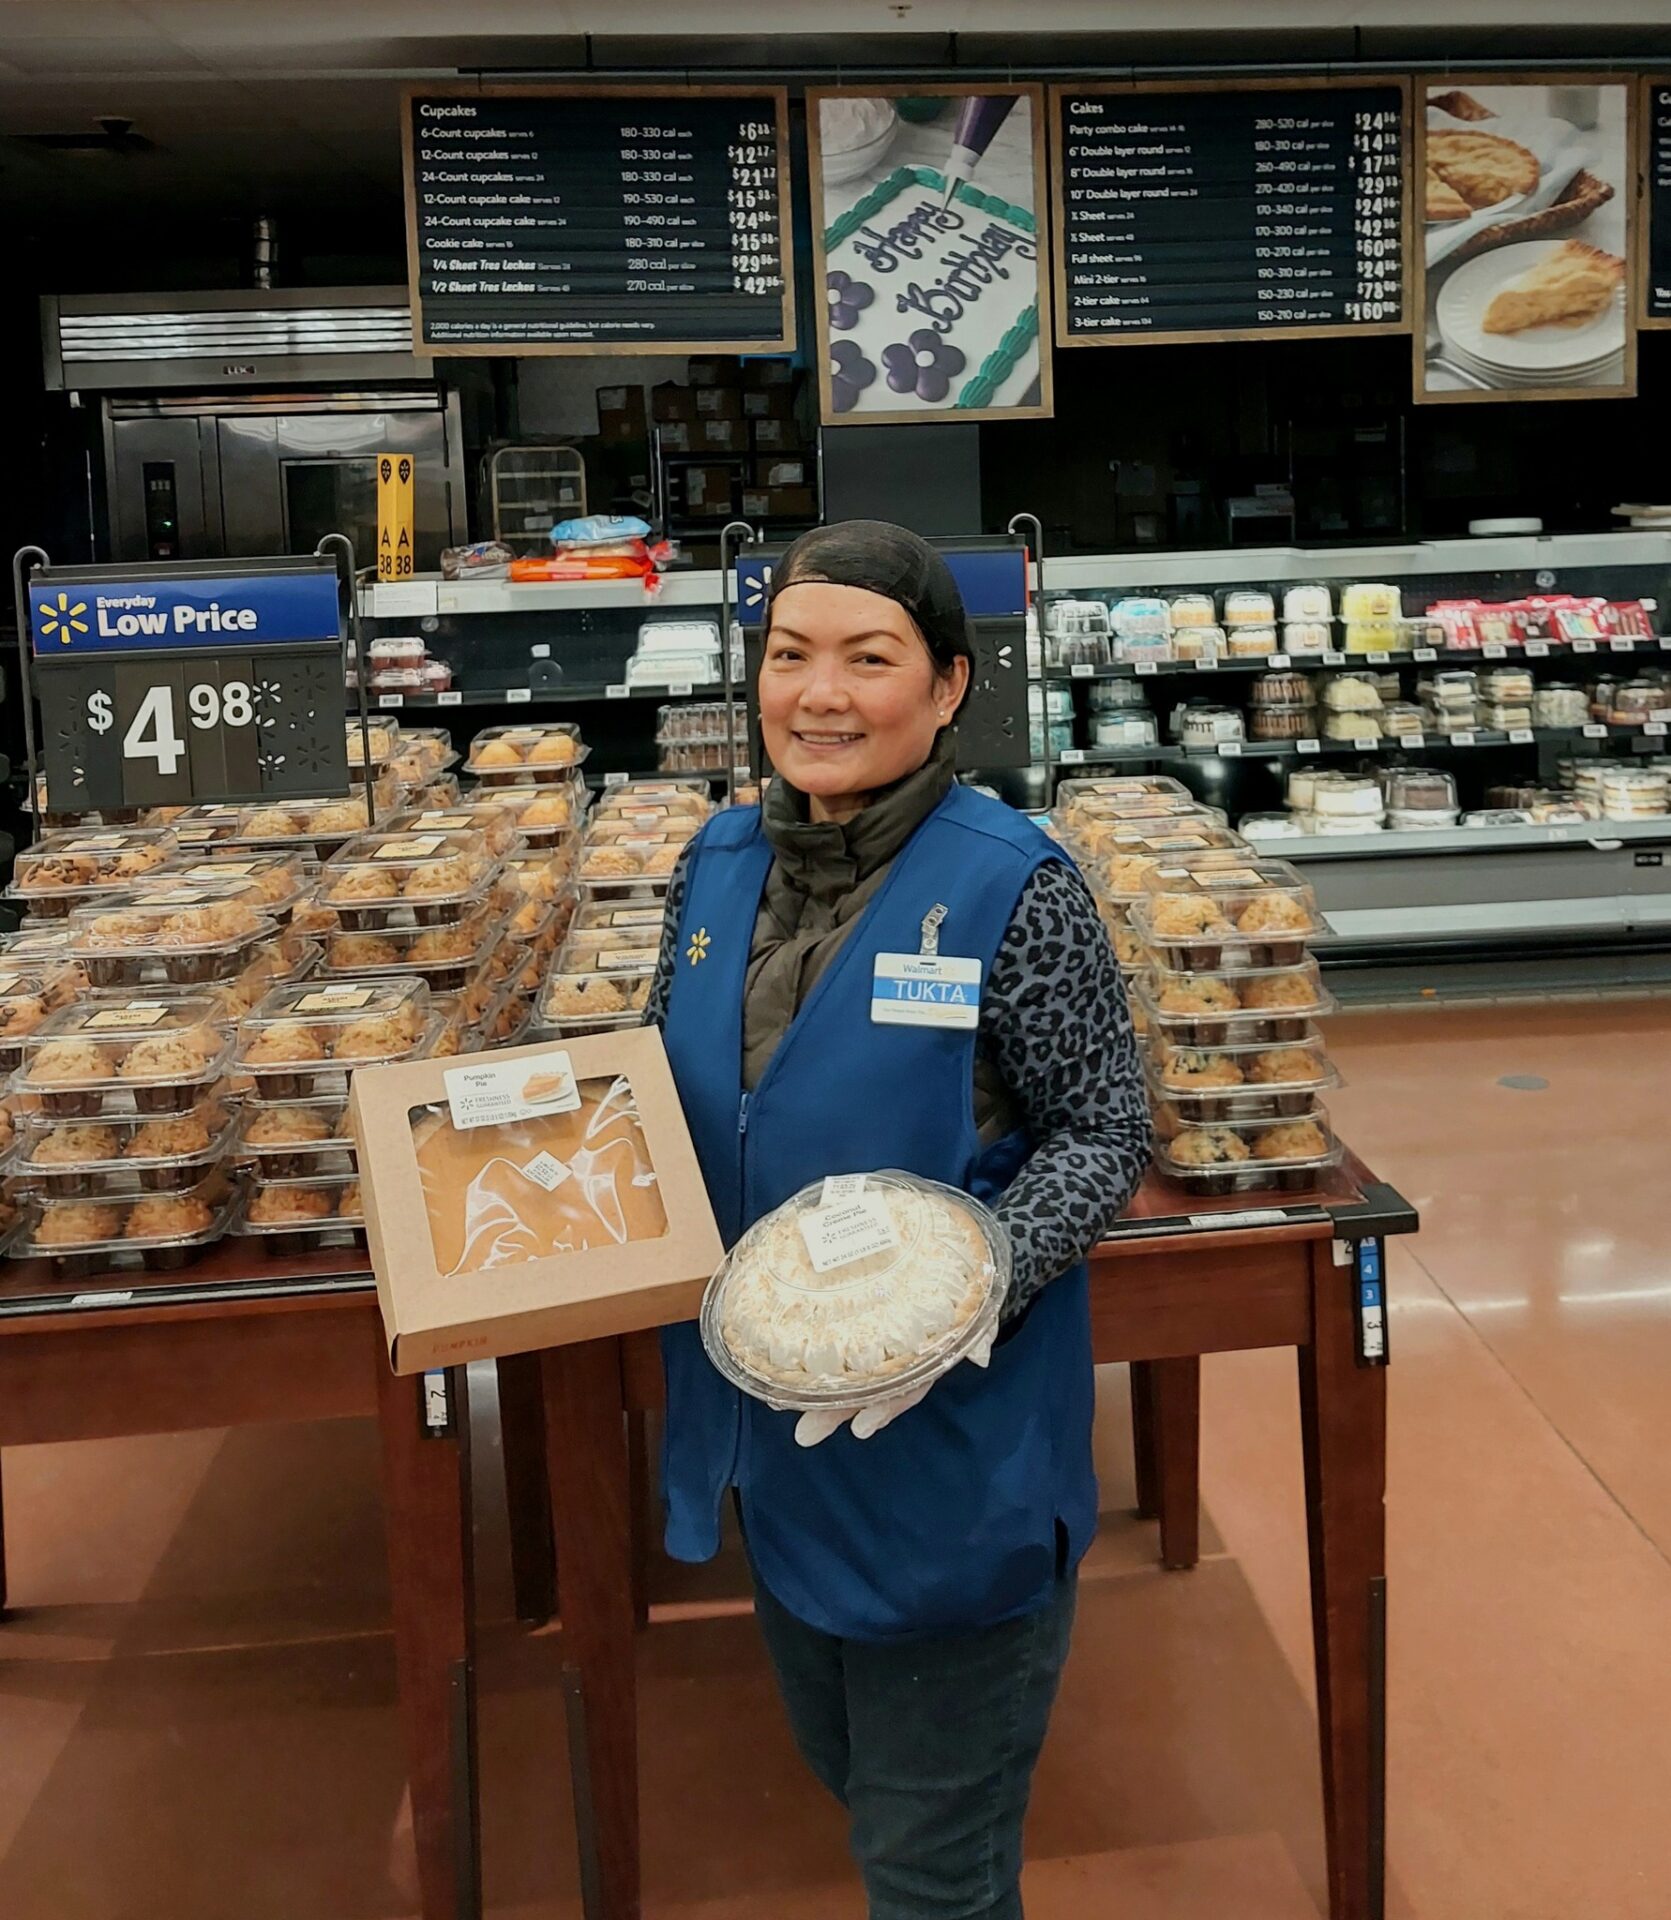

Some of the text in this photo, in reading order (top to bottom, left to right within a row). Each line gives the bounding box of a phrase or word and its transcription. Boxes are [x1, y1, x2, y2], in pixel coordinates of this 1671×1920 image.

[420, 105, 477, 119] Cupcakes
[1071, 102, 1103, 114] Cakes
[1296, 119, 1309, 128] cal
[421, 128, 462, 138] 6-Count
[463, 128, 507, 140] cupcakes
[621, 127, 676, 137] 180-330 cal
[1070, 124, 1148, 136] Party combo cake
[1081, 146, 1113, 156] Double
[1114, 146, 1135, 157] layer
[1137, 144, 1164, 154] round
[1292, 141, 1304, 150] cal
[421, 150, 464, 160] 12-Count
[466, 150, 509, 162] cupcakes
[621, 150, 676, 160] 180-330 cal
[1298, 162, 1310, 170] cal
[621, 172, 676, 181] 180-330 cal
[1083, 168, 1115, 177] Double
[1116, 167, 1138, 178] layer
[1139, 166, 1165, 175] round
[422, 172, 468, 181] 24-Count
[470, 172, 513, 184] cupcakes
[1296, 183, 1309, 192] cal
[665, 195, 678, 203] cal
[1086, 189, 1118, 199] Double
[1120, 189, 1141, 200] layer
[1143, 187, 1169, 197] round
[424, 194, 466, 204] 12-Count
[469, 194, 507, 206] cupcake
[509, 194, 531, 203] cake
[1295, 205, 1308, 214] cal
[666, 216, 680, 225] cal
[1080, 211, 1105, 220] Sheet
[425, 216, 471, 226] 24-Count
[473, 216, 512, 228] cupcake
[514, 216, 536, 225] cake
[1294, 225, 1307, 235] cal
[664, 238, 678, 247] cal
[853, 201, 964, 273] Happy
[1079, 233, 1105, 242] Sheet
[426, 238, 460, 248] Cookie
[462, 238, 484, 248] cake
[1292, 247, 1305, 256] cal
[627, 258, 667, 269] 280 cal
[1072, 254, 1113, 263] Full sheet
[449, 260, 478, 270] Sheet
[480, 259, 500, 270] Tres
[502, 260, 536, 270] Leches
[897, 222, 1037, 334] Birthday
[1294, 268, 1307, 277] cal
[1074, 274, 1119, 284] Mini 2-tier
[432, 281, 447, 292] 1/2
[448, 281, 477, 292] Sheet
[479, 281, 500, 292] Tres
[502, 281, 535, 291] Leches
[626, 280, 666, 291] 270 cal
[1295, 289, 1308, 298] cal
[1074, 295, 1121, 306] 2-tier cake
[1294, 309, 1306, 319] cal
[1075, 317, 1121, 327] 3-tier cake
[381, 527, 391, 547] A
[398, 528, 410, 548] A
[380, 554, 392, 575] 38
[396, 555, 411, 575] 38
[97, 595, 156, 609] Everyday
[97, 603, 257, 637] Low Price
[903, 964, 943, 976] Walmart
[894, 980, 966, 1003] TUKTA
[464, 1072, 496, 1081] Pumpkin
[1366, 1290, 1374, 1299] 3
